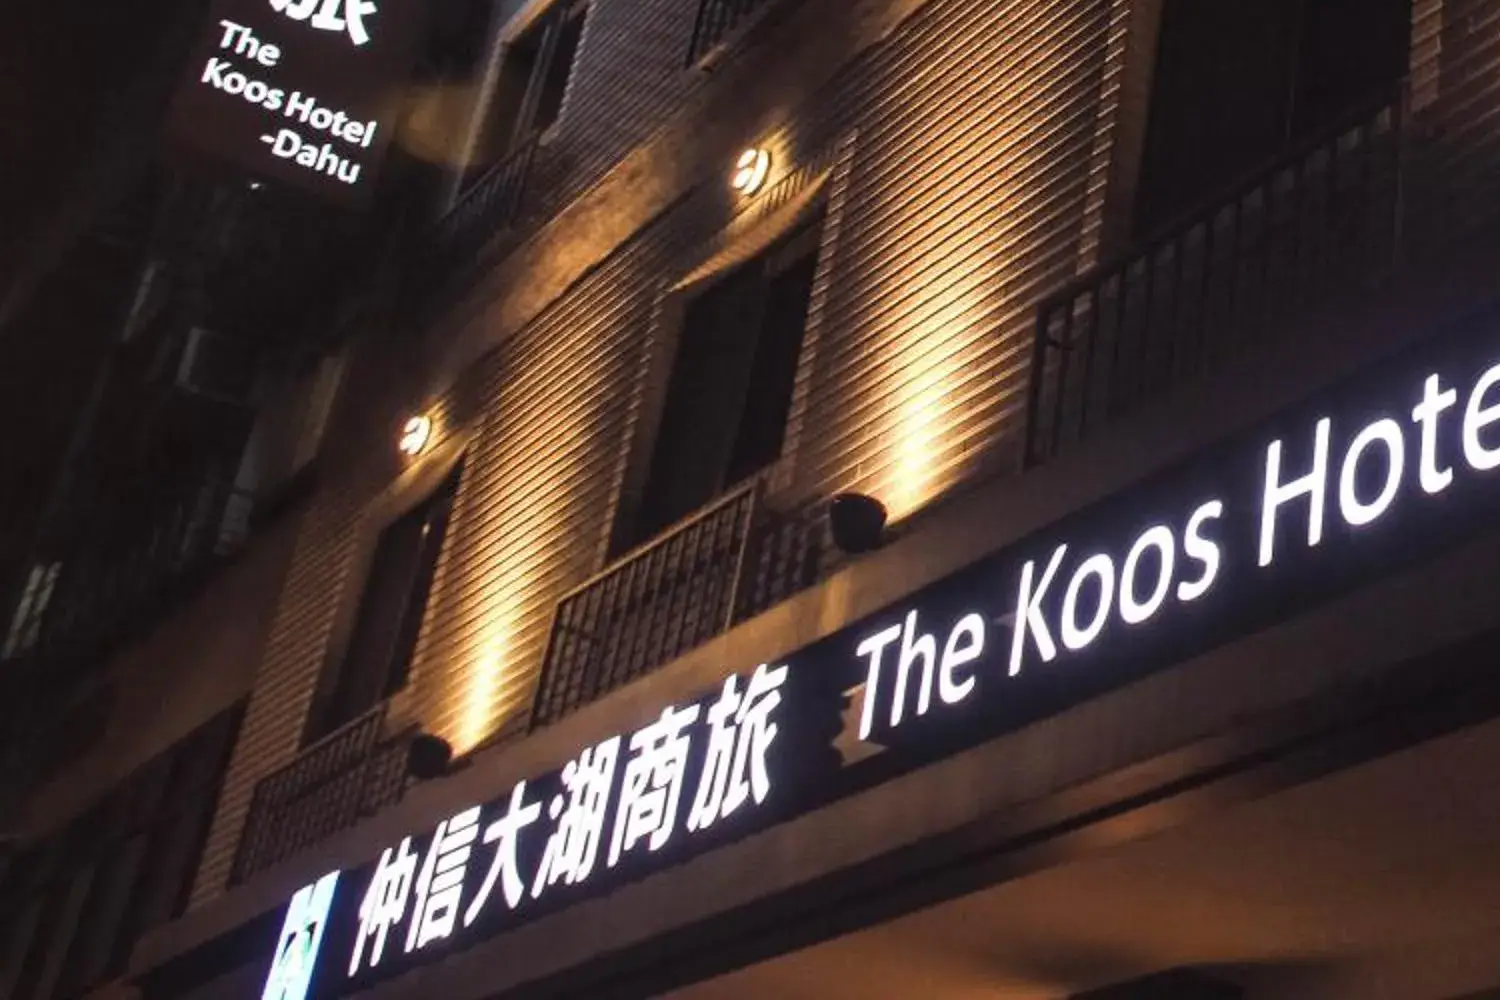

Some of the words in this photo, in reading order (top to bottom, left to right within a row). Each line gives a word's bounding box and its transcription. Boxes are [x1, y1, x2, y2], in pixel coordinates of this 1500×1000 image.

[201, 56, 285, 110] Koos
[284, 91, 378, 148] Hotel
[219, 19, 281, 67] The
[854, 608, 986, 742] The
[1007, 498, 1224, 678] Koos
[348, 662, 790, 978] 仲信大湖商旅
